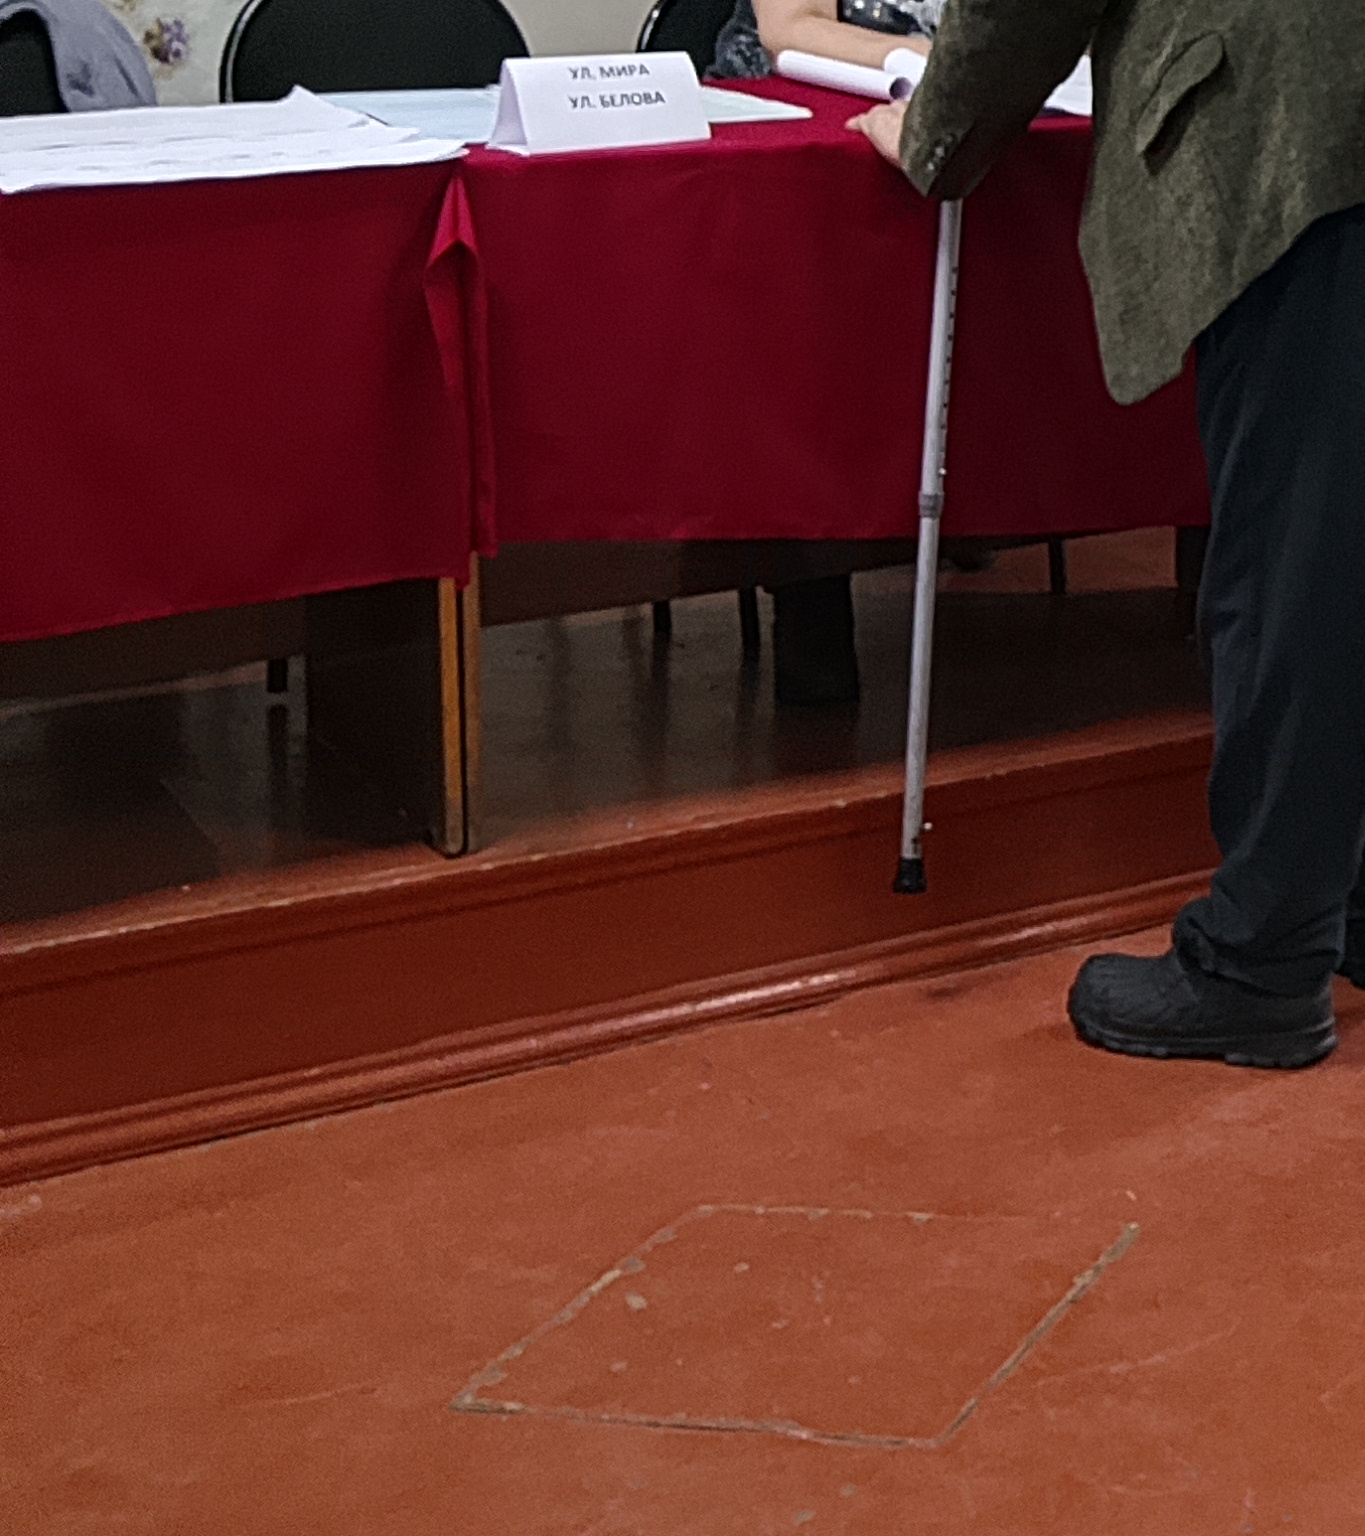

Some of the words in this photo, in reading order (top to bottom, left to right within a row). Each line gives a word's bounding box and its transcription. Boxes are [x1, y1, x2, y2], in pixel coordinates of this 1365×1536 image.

[568, 67, 597, 80] УЛ.
[600, 64, 650, 79] МИРА
[568, 95, 597, 109] УЛ.
[600, 91, 666, 109] БЕЛОВА
